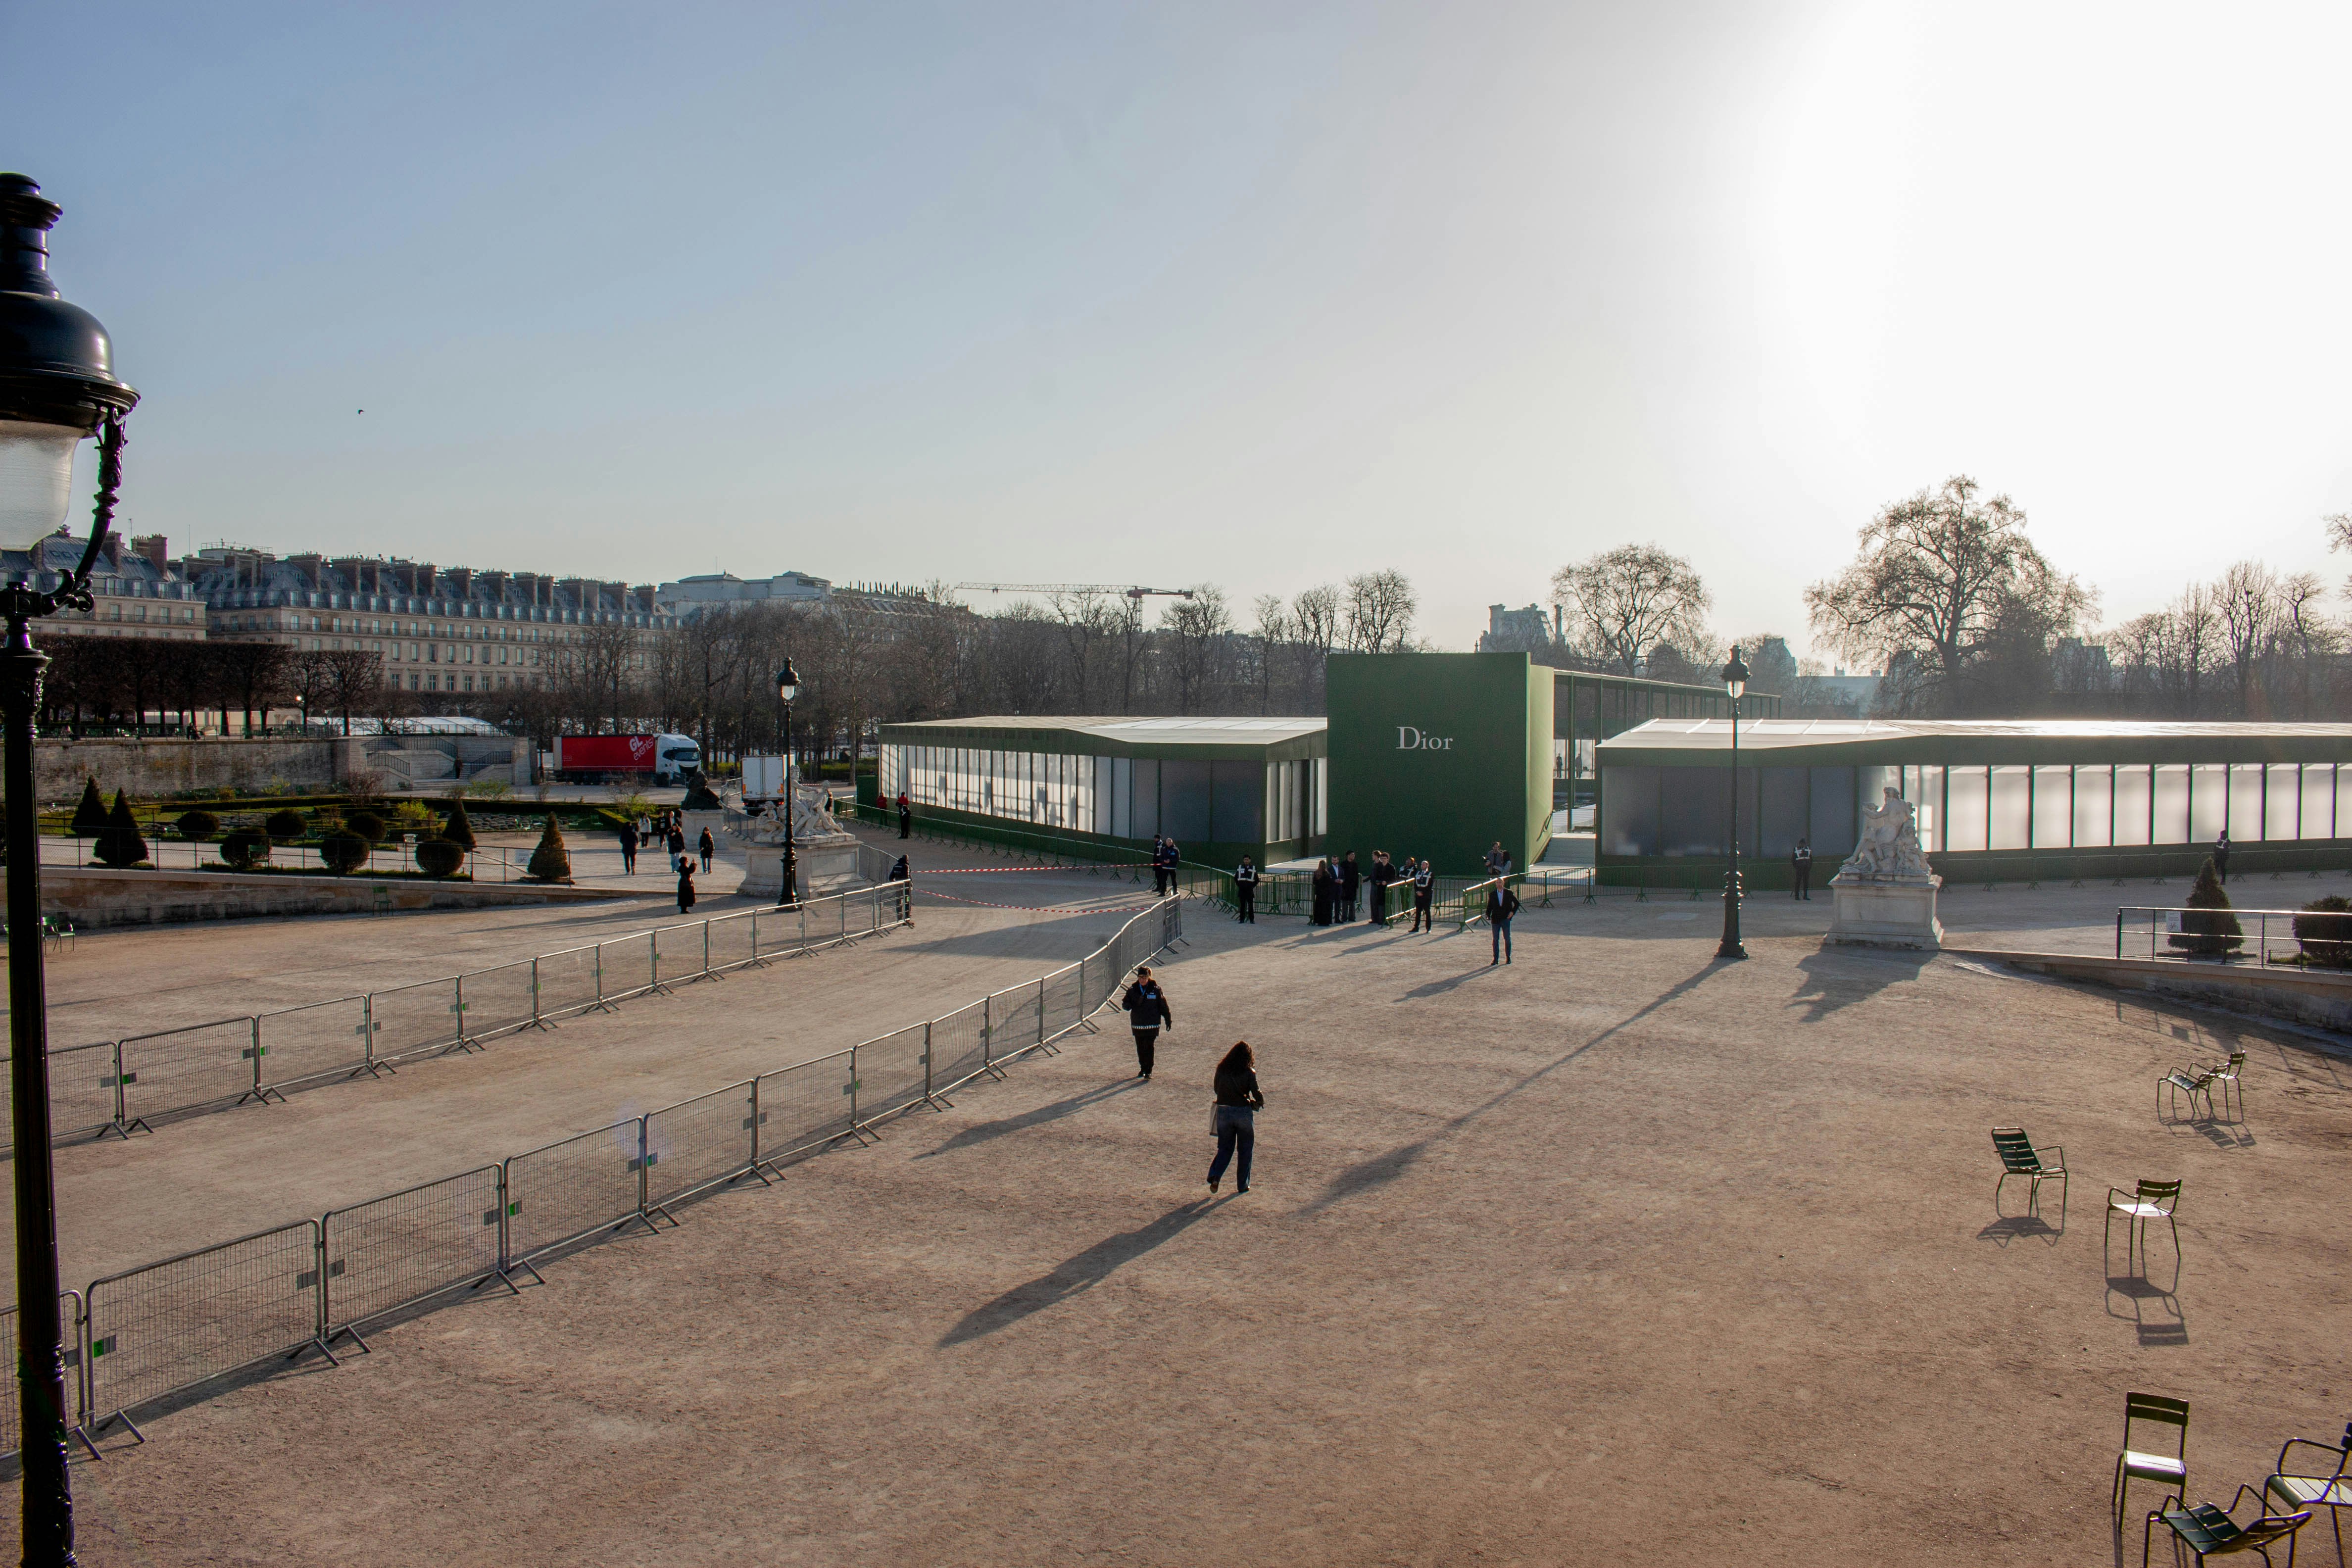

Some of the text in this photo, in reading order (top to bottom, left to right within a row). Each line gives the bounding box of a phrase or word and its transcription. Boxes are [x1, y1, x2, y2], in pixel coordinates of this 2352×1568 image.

[629, 736, 643, 751] GL
[634, 737, 654, 760] events
[1396, 726, 1453, 749] Dior
